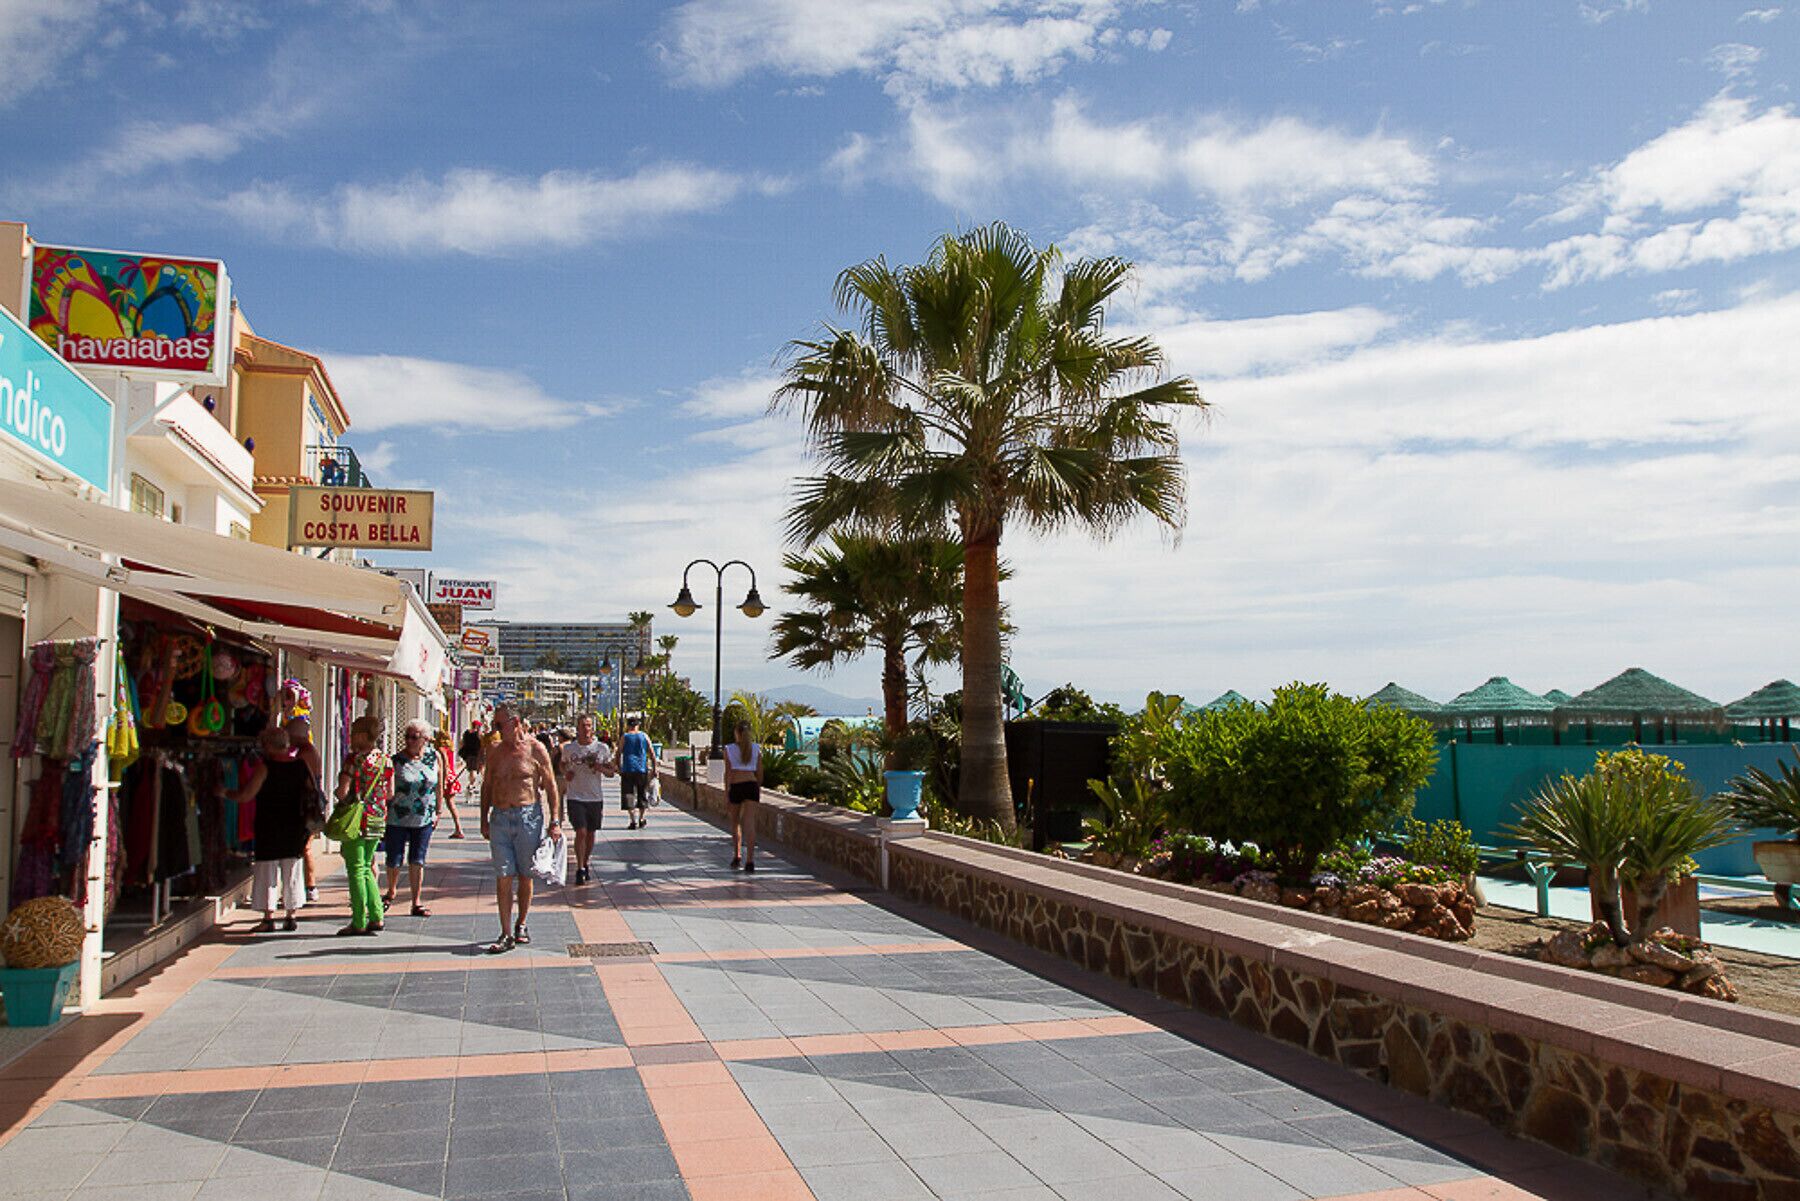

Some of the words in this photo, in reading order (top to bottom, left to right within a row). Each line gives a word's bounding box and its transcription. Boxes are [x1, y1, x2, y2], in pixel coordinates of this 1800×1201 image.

[57, 334, 211, 361] havaianas
[320, 493, 407, 514] SOUVENIR
[304, 522, 359, 541] COSTA
[368, 524, 420, 542] BELLA
[435, 587, 492, 600] JUAN
